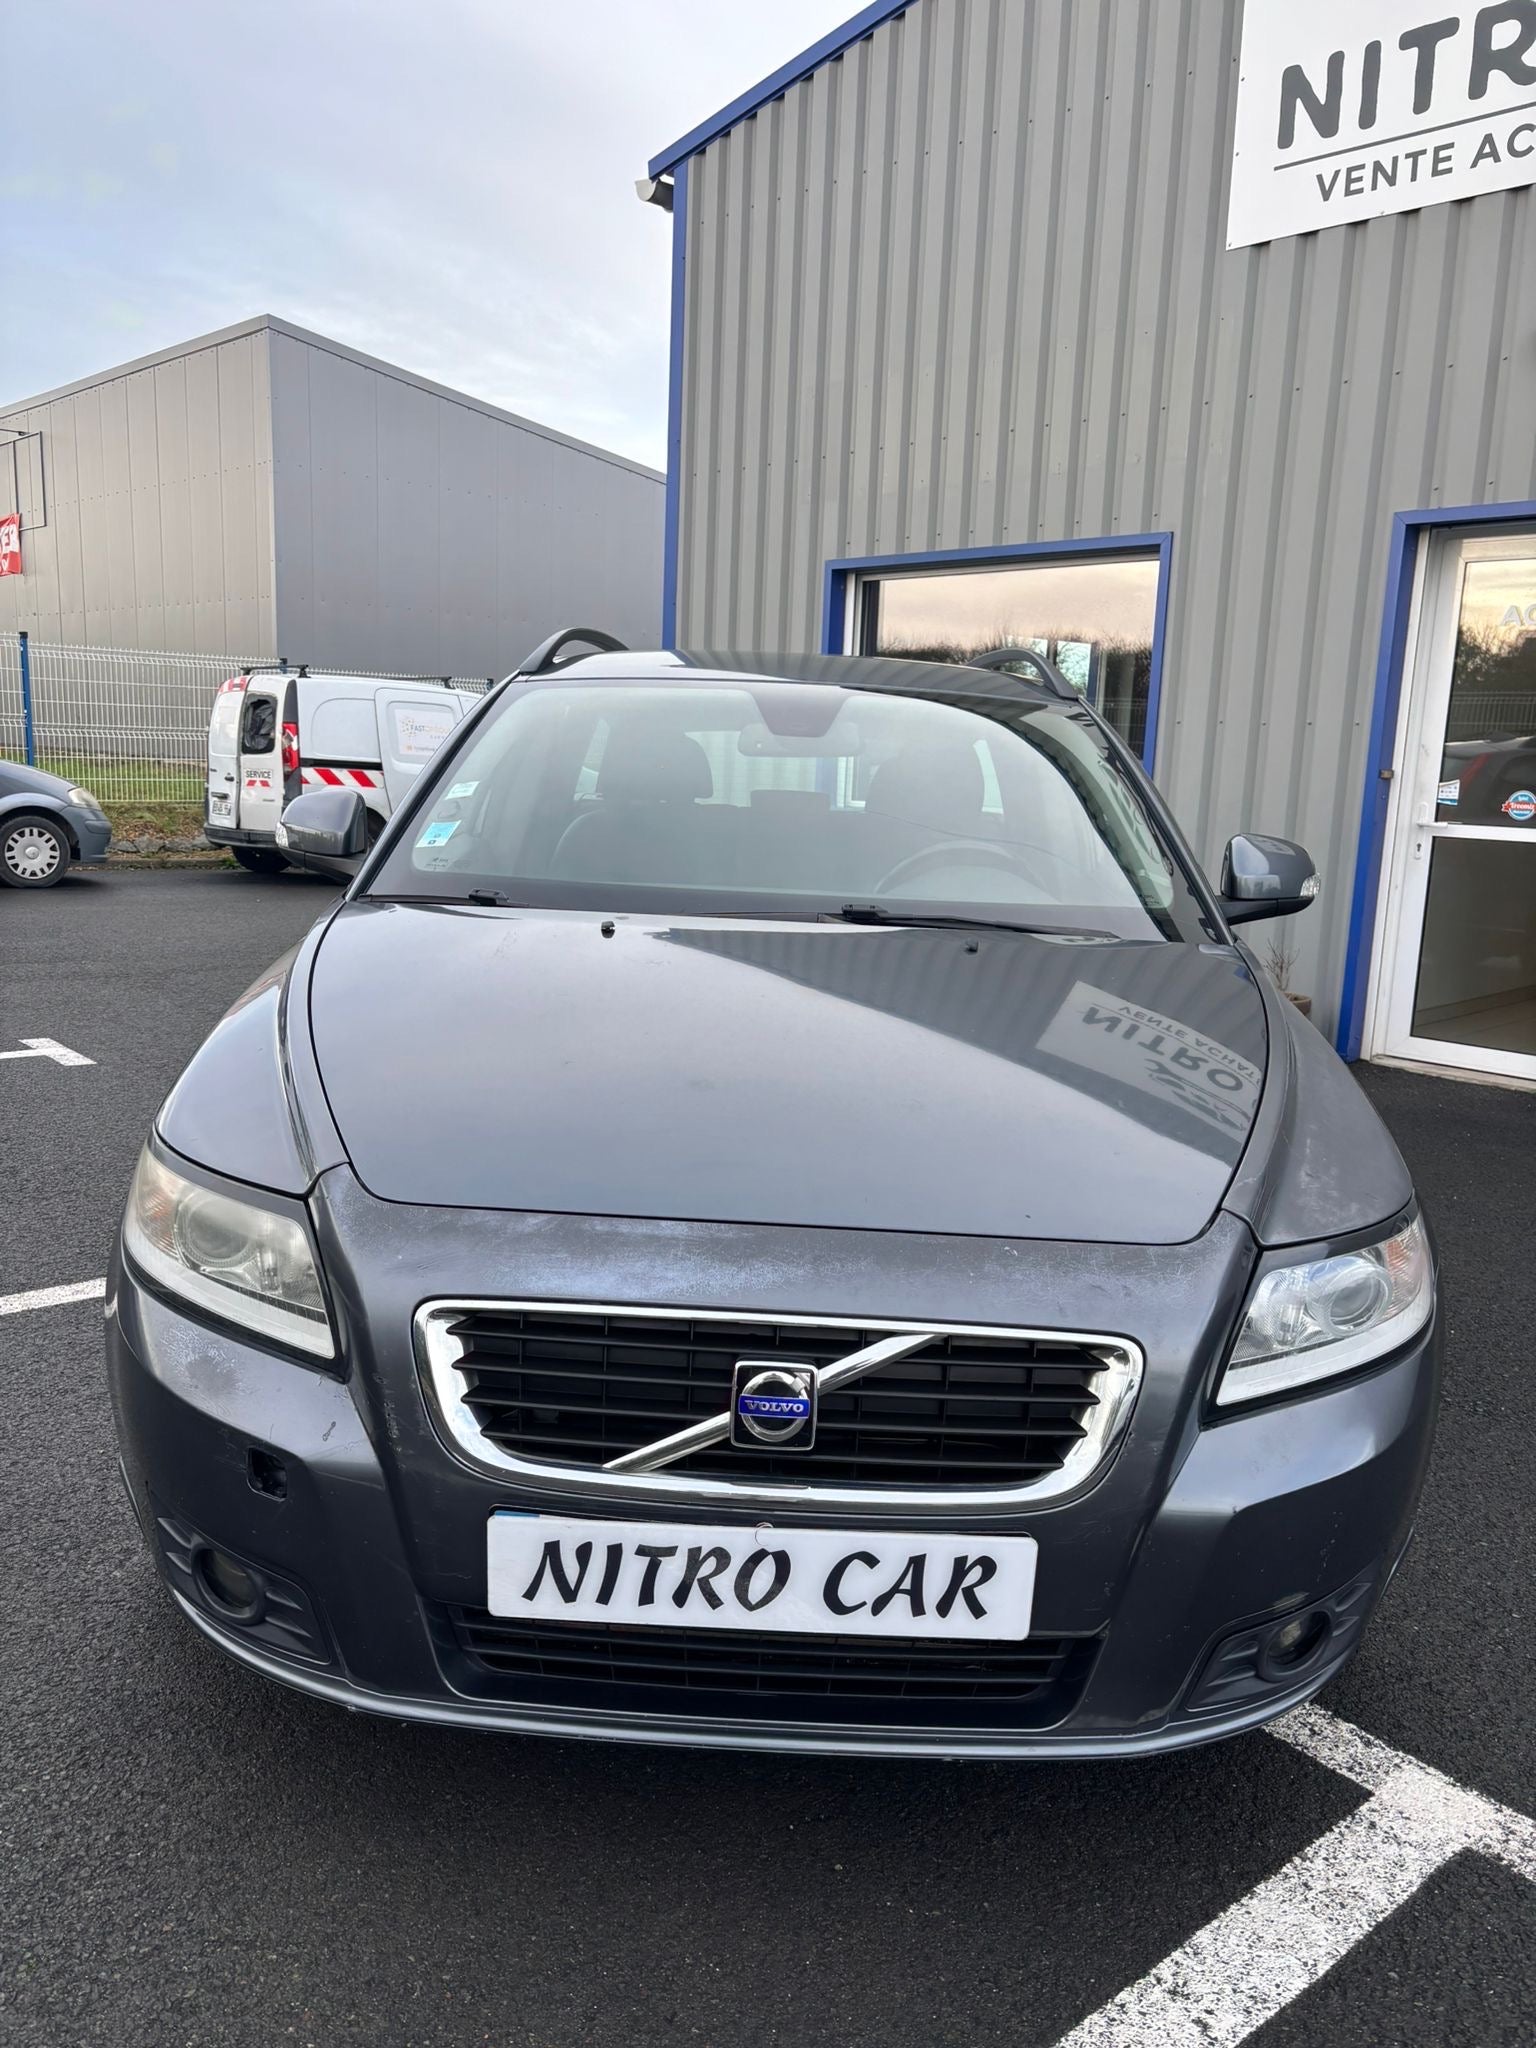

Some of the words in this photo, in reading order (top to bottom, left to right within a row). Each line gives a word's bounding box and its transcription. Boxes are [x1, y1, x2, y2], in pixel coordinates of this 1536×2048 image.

[1316, 142, 1455, 202] VENTE
[245, 769, 272, 780] SERVICE
[744, 1400, 805, 1414] VOLVO
[521, 1540, 792, 1612] NITRO
[822, 1550, 998, 1621] CAR
